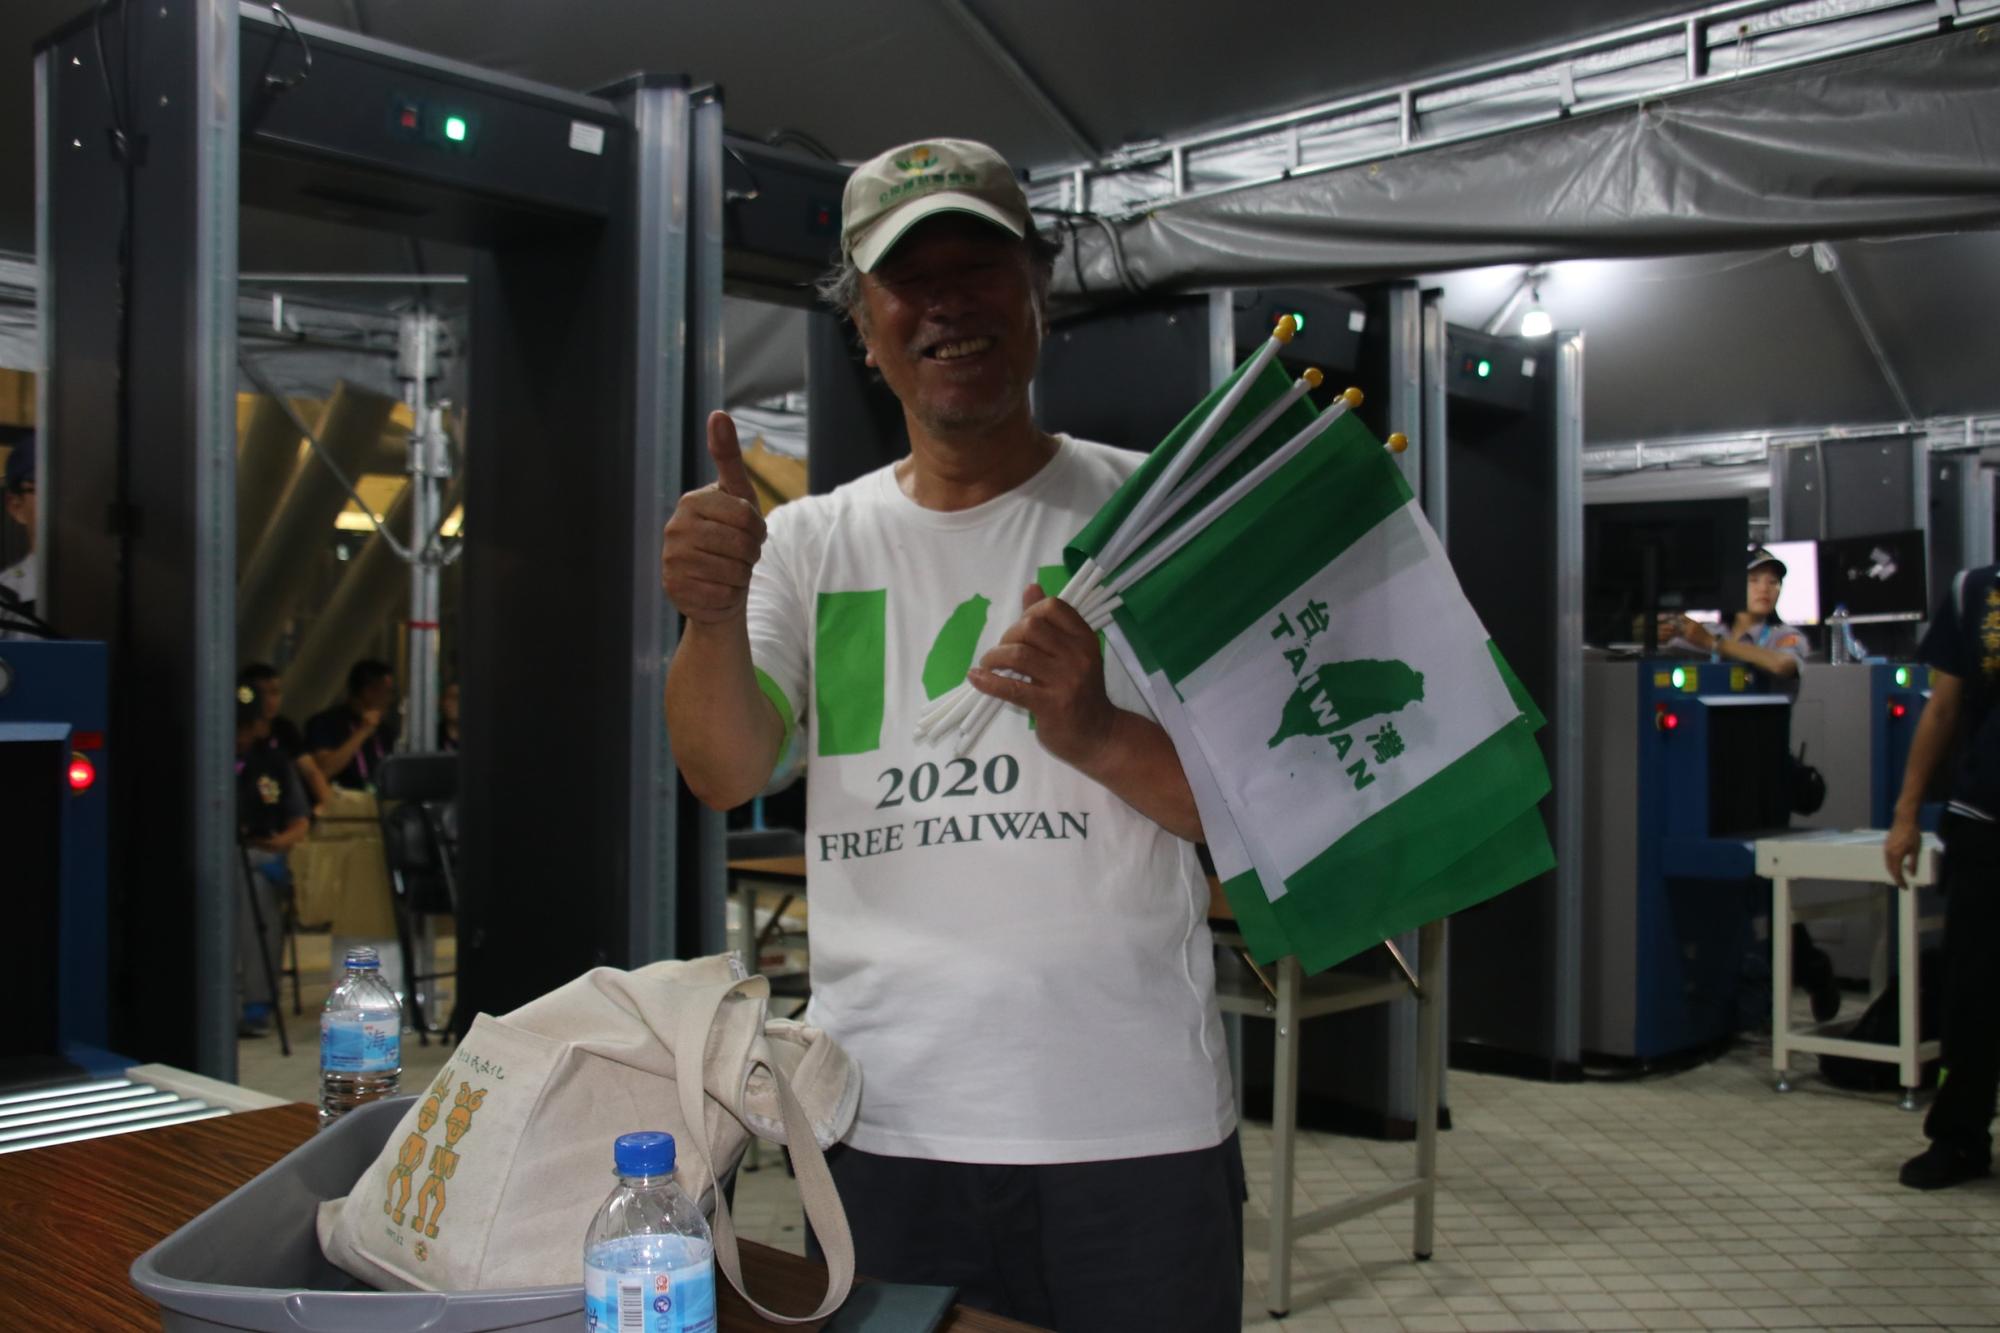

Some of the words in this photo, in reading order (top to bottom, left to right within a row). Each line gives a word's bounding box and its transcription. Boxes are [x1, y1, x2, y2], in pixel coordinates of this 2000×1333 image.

[1270, 612, 1376, 791] TAIWAN
[875, 754, 1020, 810] 2020
[818, 824, 904, 862] FREE
[913, 811, 1090, 848] TAIWAN
